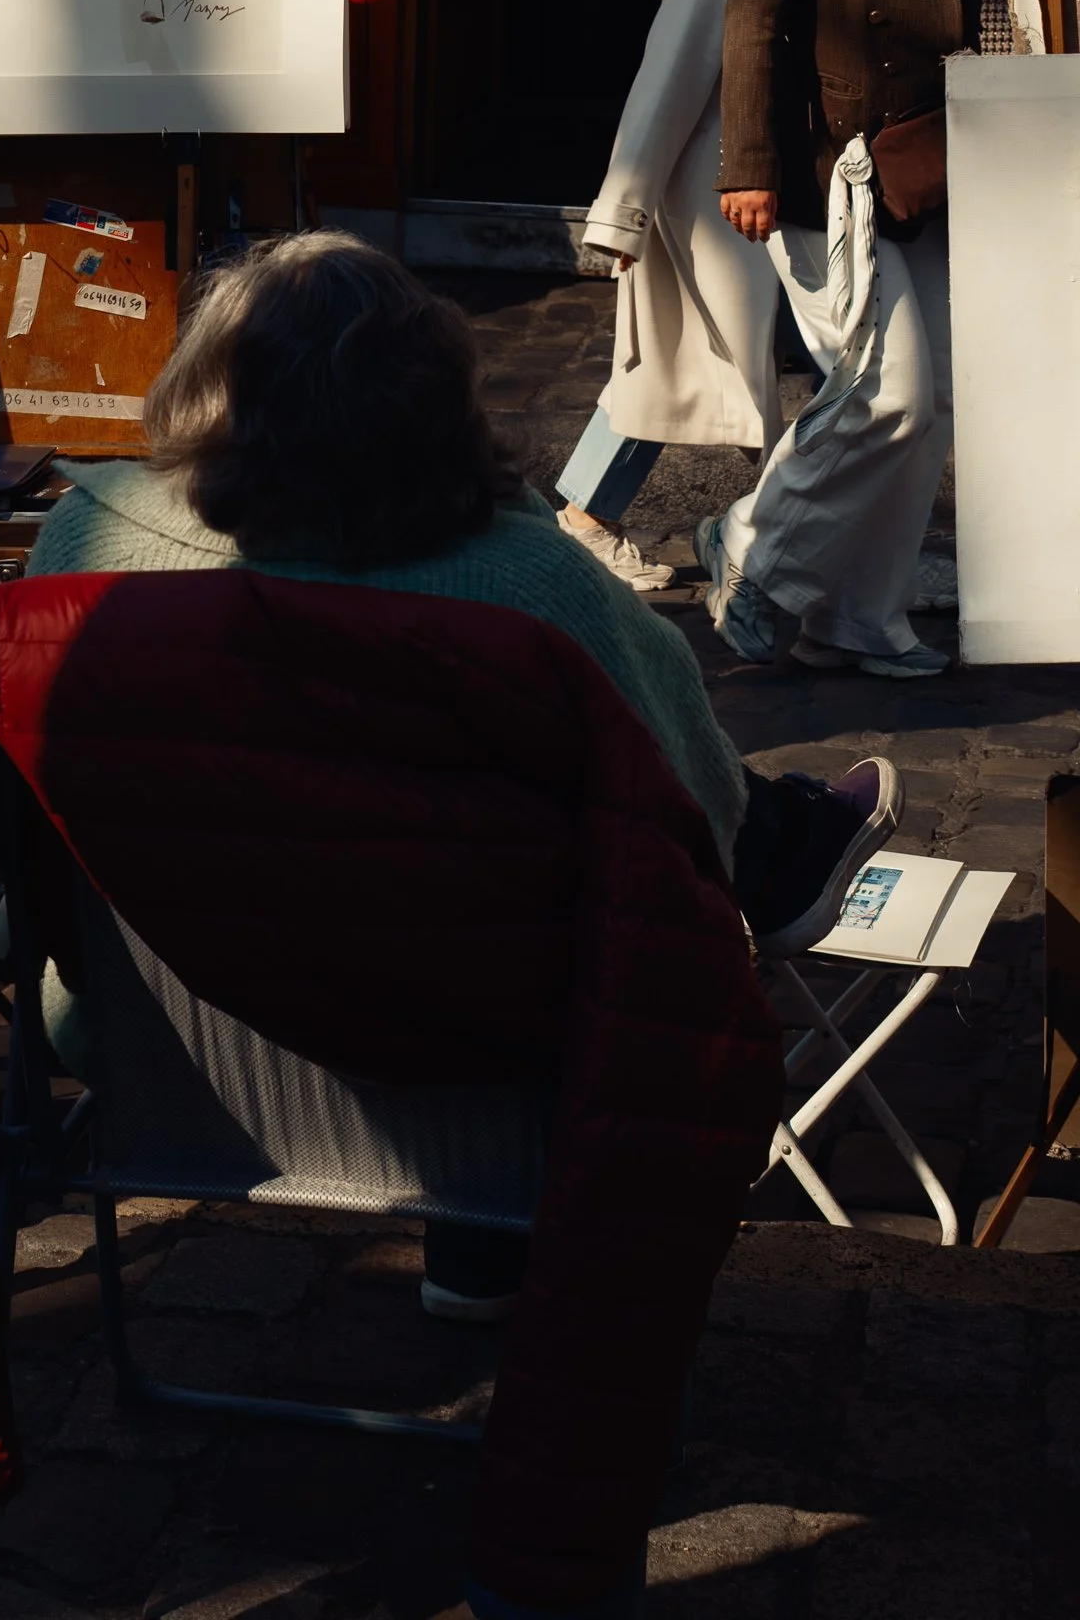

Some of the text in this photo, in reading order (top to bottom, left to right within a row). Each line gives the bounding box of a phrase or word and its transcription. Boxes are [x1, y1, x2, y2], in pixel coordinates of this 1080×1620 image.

[4, 392, 22, 405] 06
[29, 394, 43, 406] 41
[52, 395, 69, 407] 69
[77, 397, 90, 408] 16
[97, 397, 115, 408] 59
